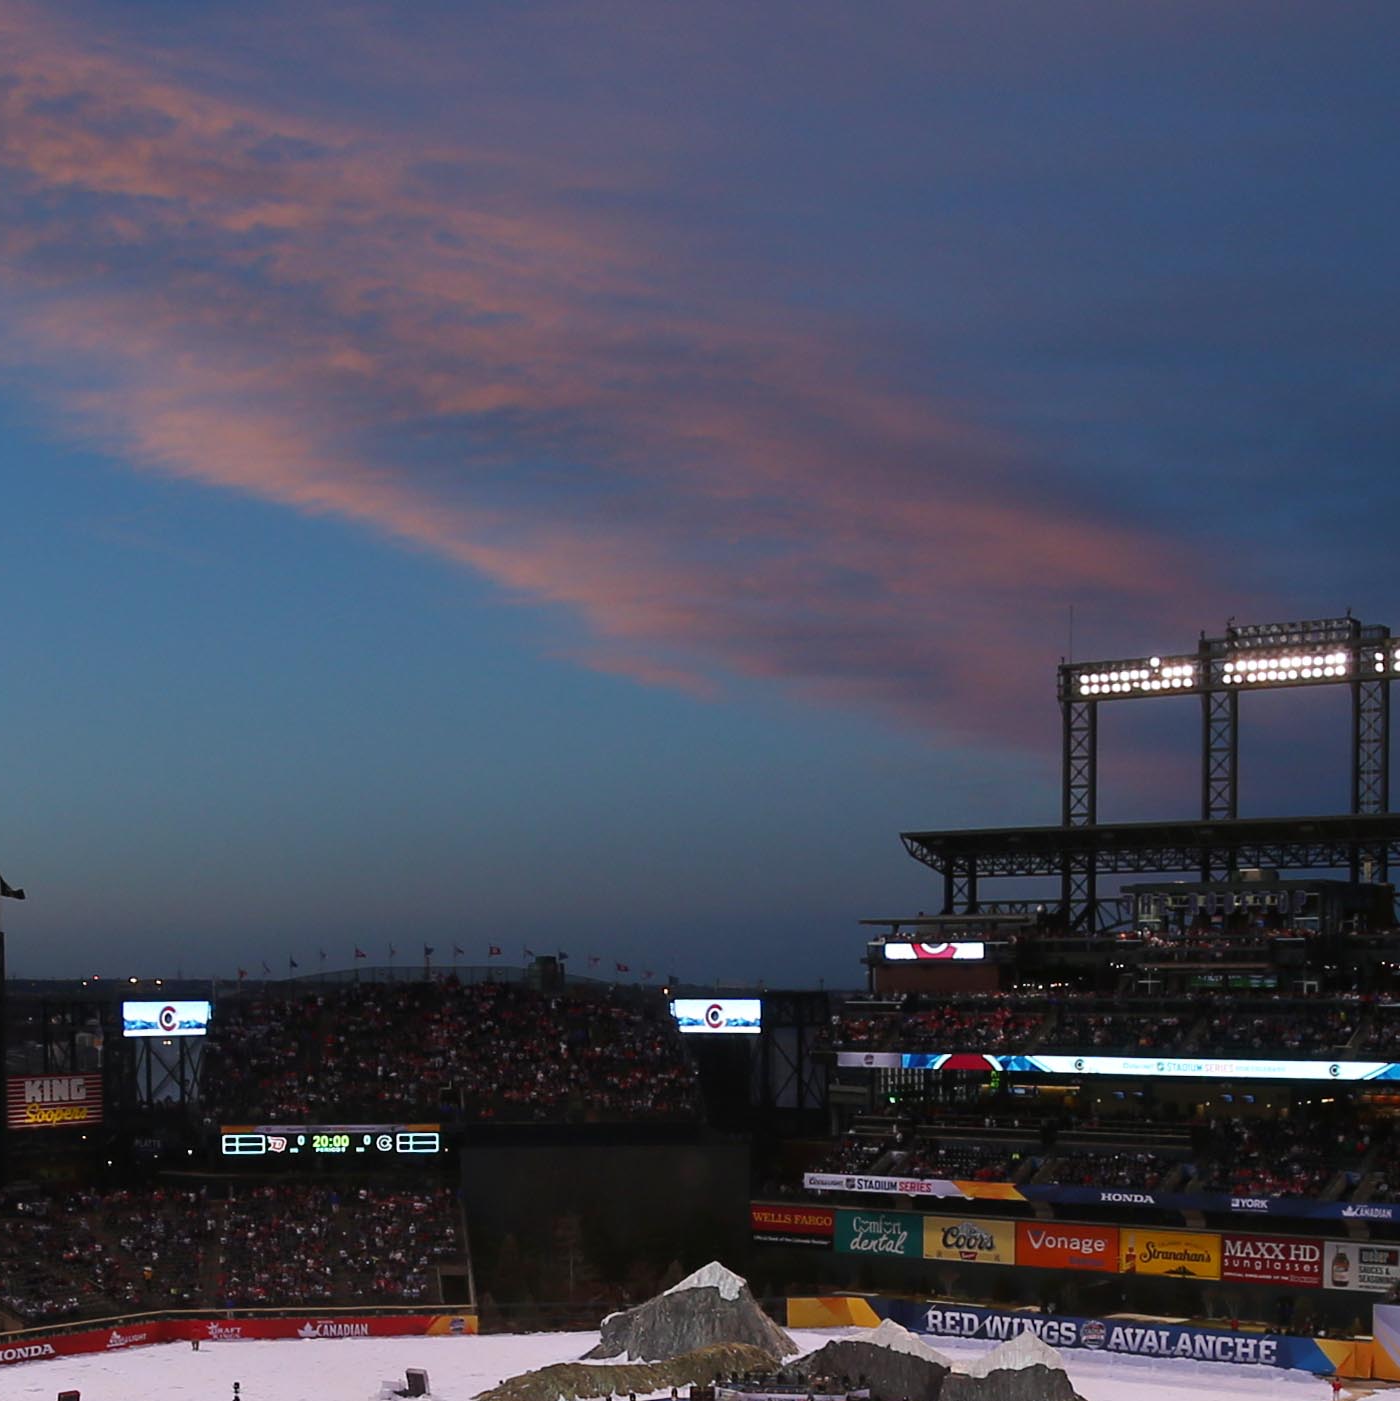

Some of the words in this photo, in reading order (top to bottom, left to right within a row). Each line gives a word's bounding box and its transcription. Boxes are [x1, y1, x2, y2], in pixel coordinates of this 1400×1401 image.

[25, 1078, 86, 1102] KING
[25, 1102, 88, 1127] Soopers
[312, 1135, 349, 1147] 20:00
[857, 1178, 897, 1191] STADIUM
[898, 1182, 932, 1193] SERIES
[1101, 1192, 1155, 1204] HONDA
[1239, 1198, 1268, 1209] YORK
[753, 1211, 792, 1225] WELLS
[794, 1214, 833, 1226] FARGO
[850, 1231, 905, 1255] dental
[942, 1225, 995, 1251] Coors
[1027, 1229, 1106, 1254] Vonage
[1140, 1241, 1211, 1265] Stranahan's
[1223, 1240, 1286, 1259] MAXX
[1290, 1243, 1320, 1263] HD
[1223, 1258, 1320, 1274] sunglasses
[315, 1323, 368, 1337] CANADIAN
[926, 1309, 979, 1336] RED
[985, 1316, 1076, 1346] WINGS
[1106, 1326, 1277, 1365] AVALANCHE
